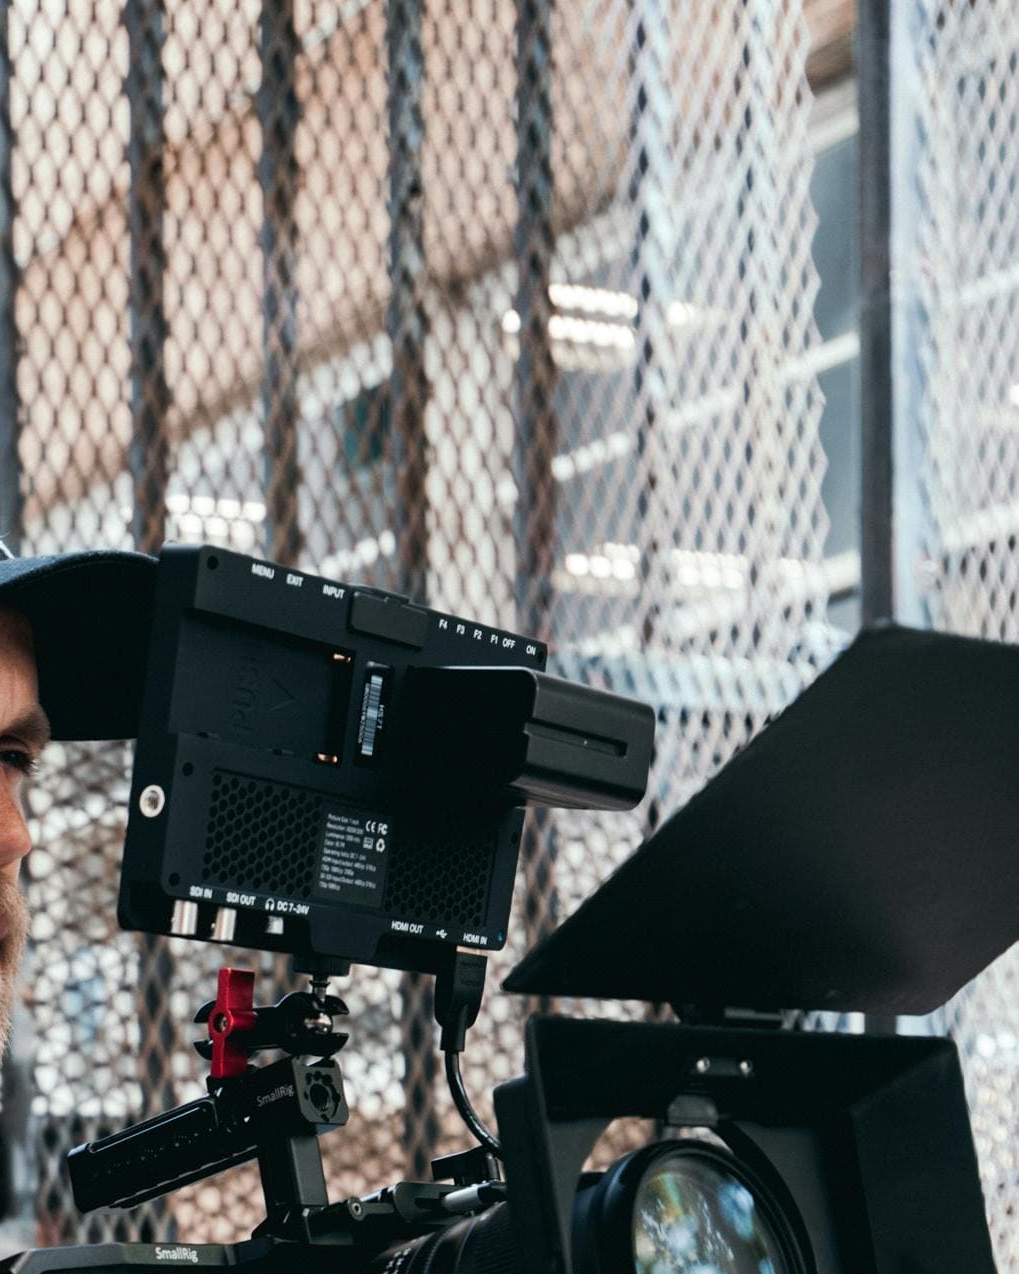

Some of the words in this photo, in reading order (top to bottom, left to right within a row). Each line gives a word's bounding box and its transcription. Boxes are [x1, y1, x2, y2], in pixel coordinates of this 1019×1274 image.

[251, 563, 275, 580] MENU
[286, 573, 304, 588] EXIT
[322, 584, 345, 600] INPUT
[438, 619, 448, 630] F4
[456, 624, 466, 636] F3
[473, 629, 483, 640] F2
[490, 634, 499, 645] F1
[502, 637, 516, 649] OFF
[525, 644, 537, 656] ON
[189, 885, 204, 897] SDI
[204, 888, 213, 899] IN
[226, 891, 240, 904] SDI
[240, 893, 257, 906] OUT
[276, 900, 288, 912] DC
[391, 920, 409, 932] HDMI
[409, 923, 424, 934] OUT
[463, 932, 480, 944] HDMI
[480, 935, 488, 945] IN
[256, 1085, 294, 1107] SmallRig
[155, 1246, 198, 1263] SmallRig
